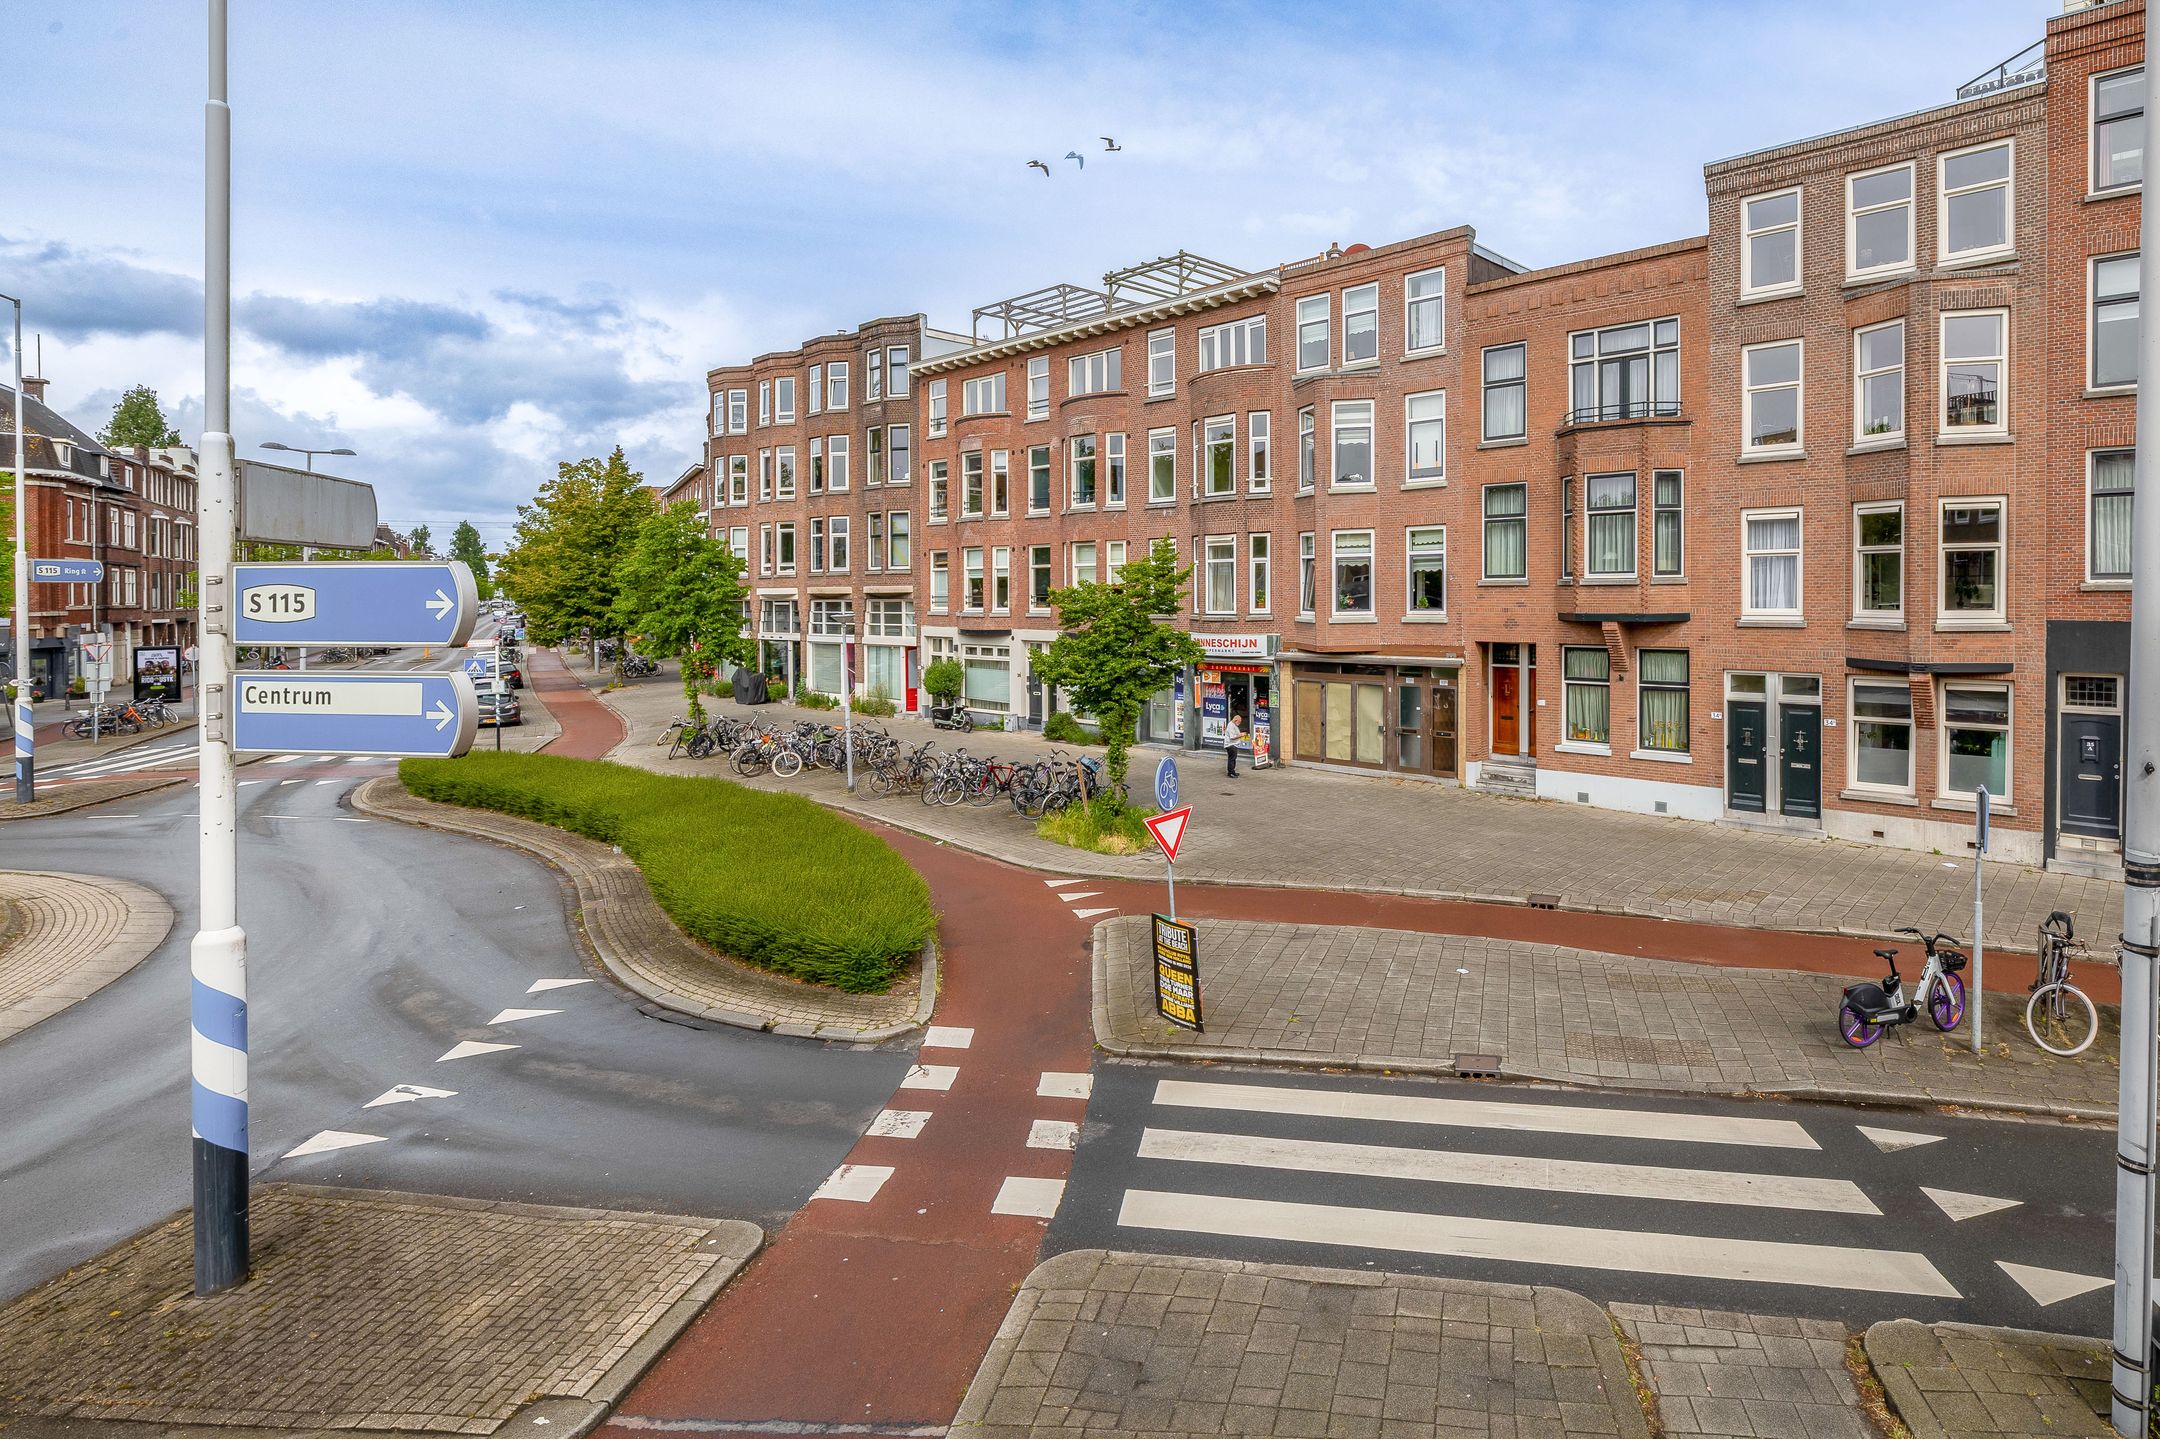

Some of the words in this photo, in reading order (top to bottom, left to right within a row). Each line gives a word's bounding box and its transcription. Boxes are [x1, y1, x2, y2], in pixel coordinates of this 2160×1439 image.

[64, 567, 80, 575] Ring
[249, 593, 262, 613] S
[268, 593, 305, 613] 115
[245, 686, 332, 705] Centrum
[1205, 701, 1221, 711] Lyca
[1158, 921, 1188, 944] TRIBUTE
[1159, 964, 1193, 986] QUEEN
[1172, 985, 1194, 999] MAAR
[1162, 998, 1196, 1023] ABBA
